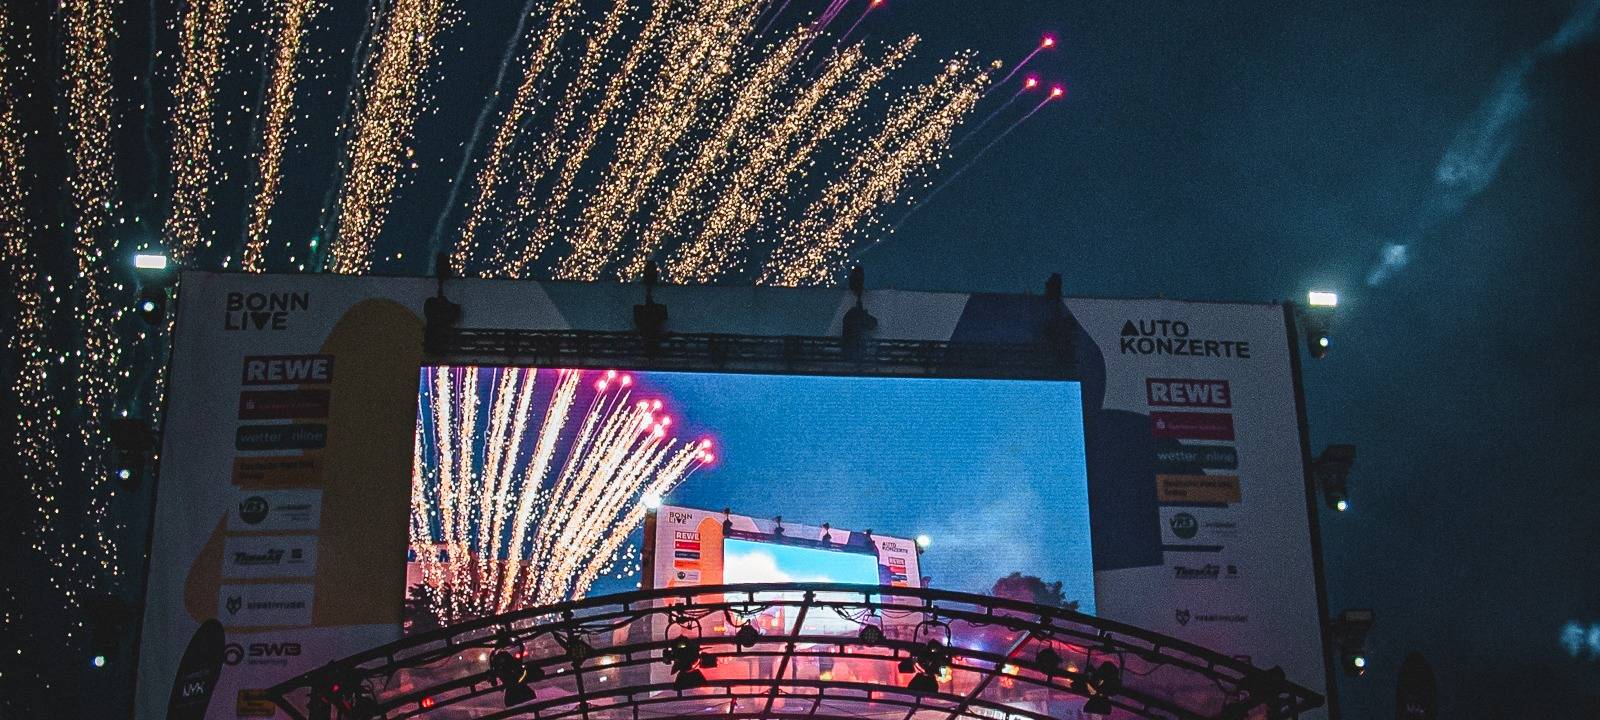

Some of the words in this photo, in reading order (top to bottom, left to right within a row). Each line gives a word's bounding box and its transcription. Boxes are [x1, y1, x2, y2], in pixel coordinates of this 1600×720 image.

[226, 292, 309, 311] BONN
[224, 311, 288, 330] LIVE
[1120, 319, 1189, 337] AUTO
[1120, 338, 1250, 358] KONZERTE
[247, 359, 328, 381] REWE
[1151, 382, 1227, 404] REWE
[669, 511, 693, 520] BONN
[669, 517, 687, 525] LIVE
[248, 643, 302, 657] SWB
